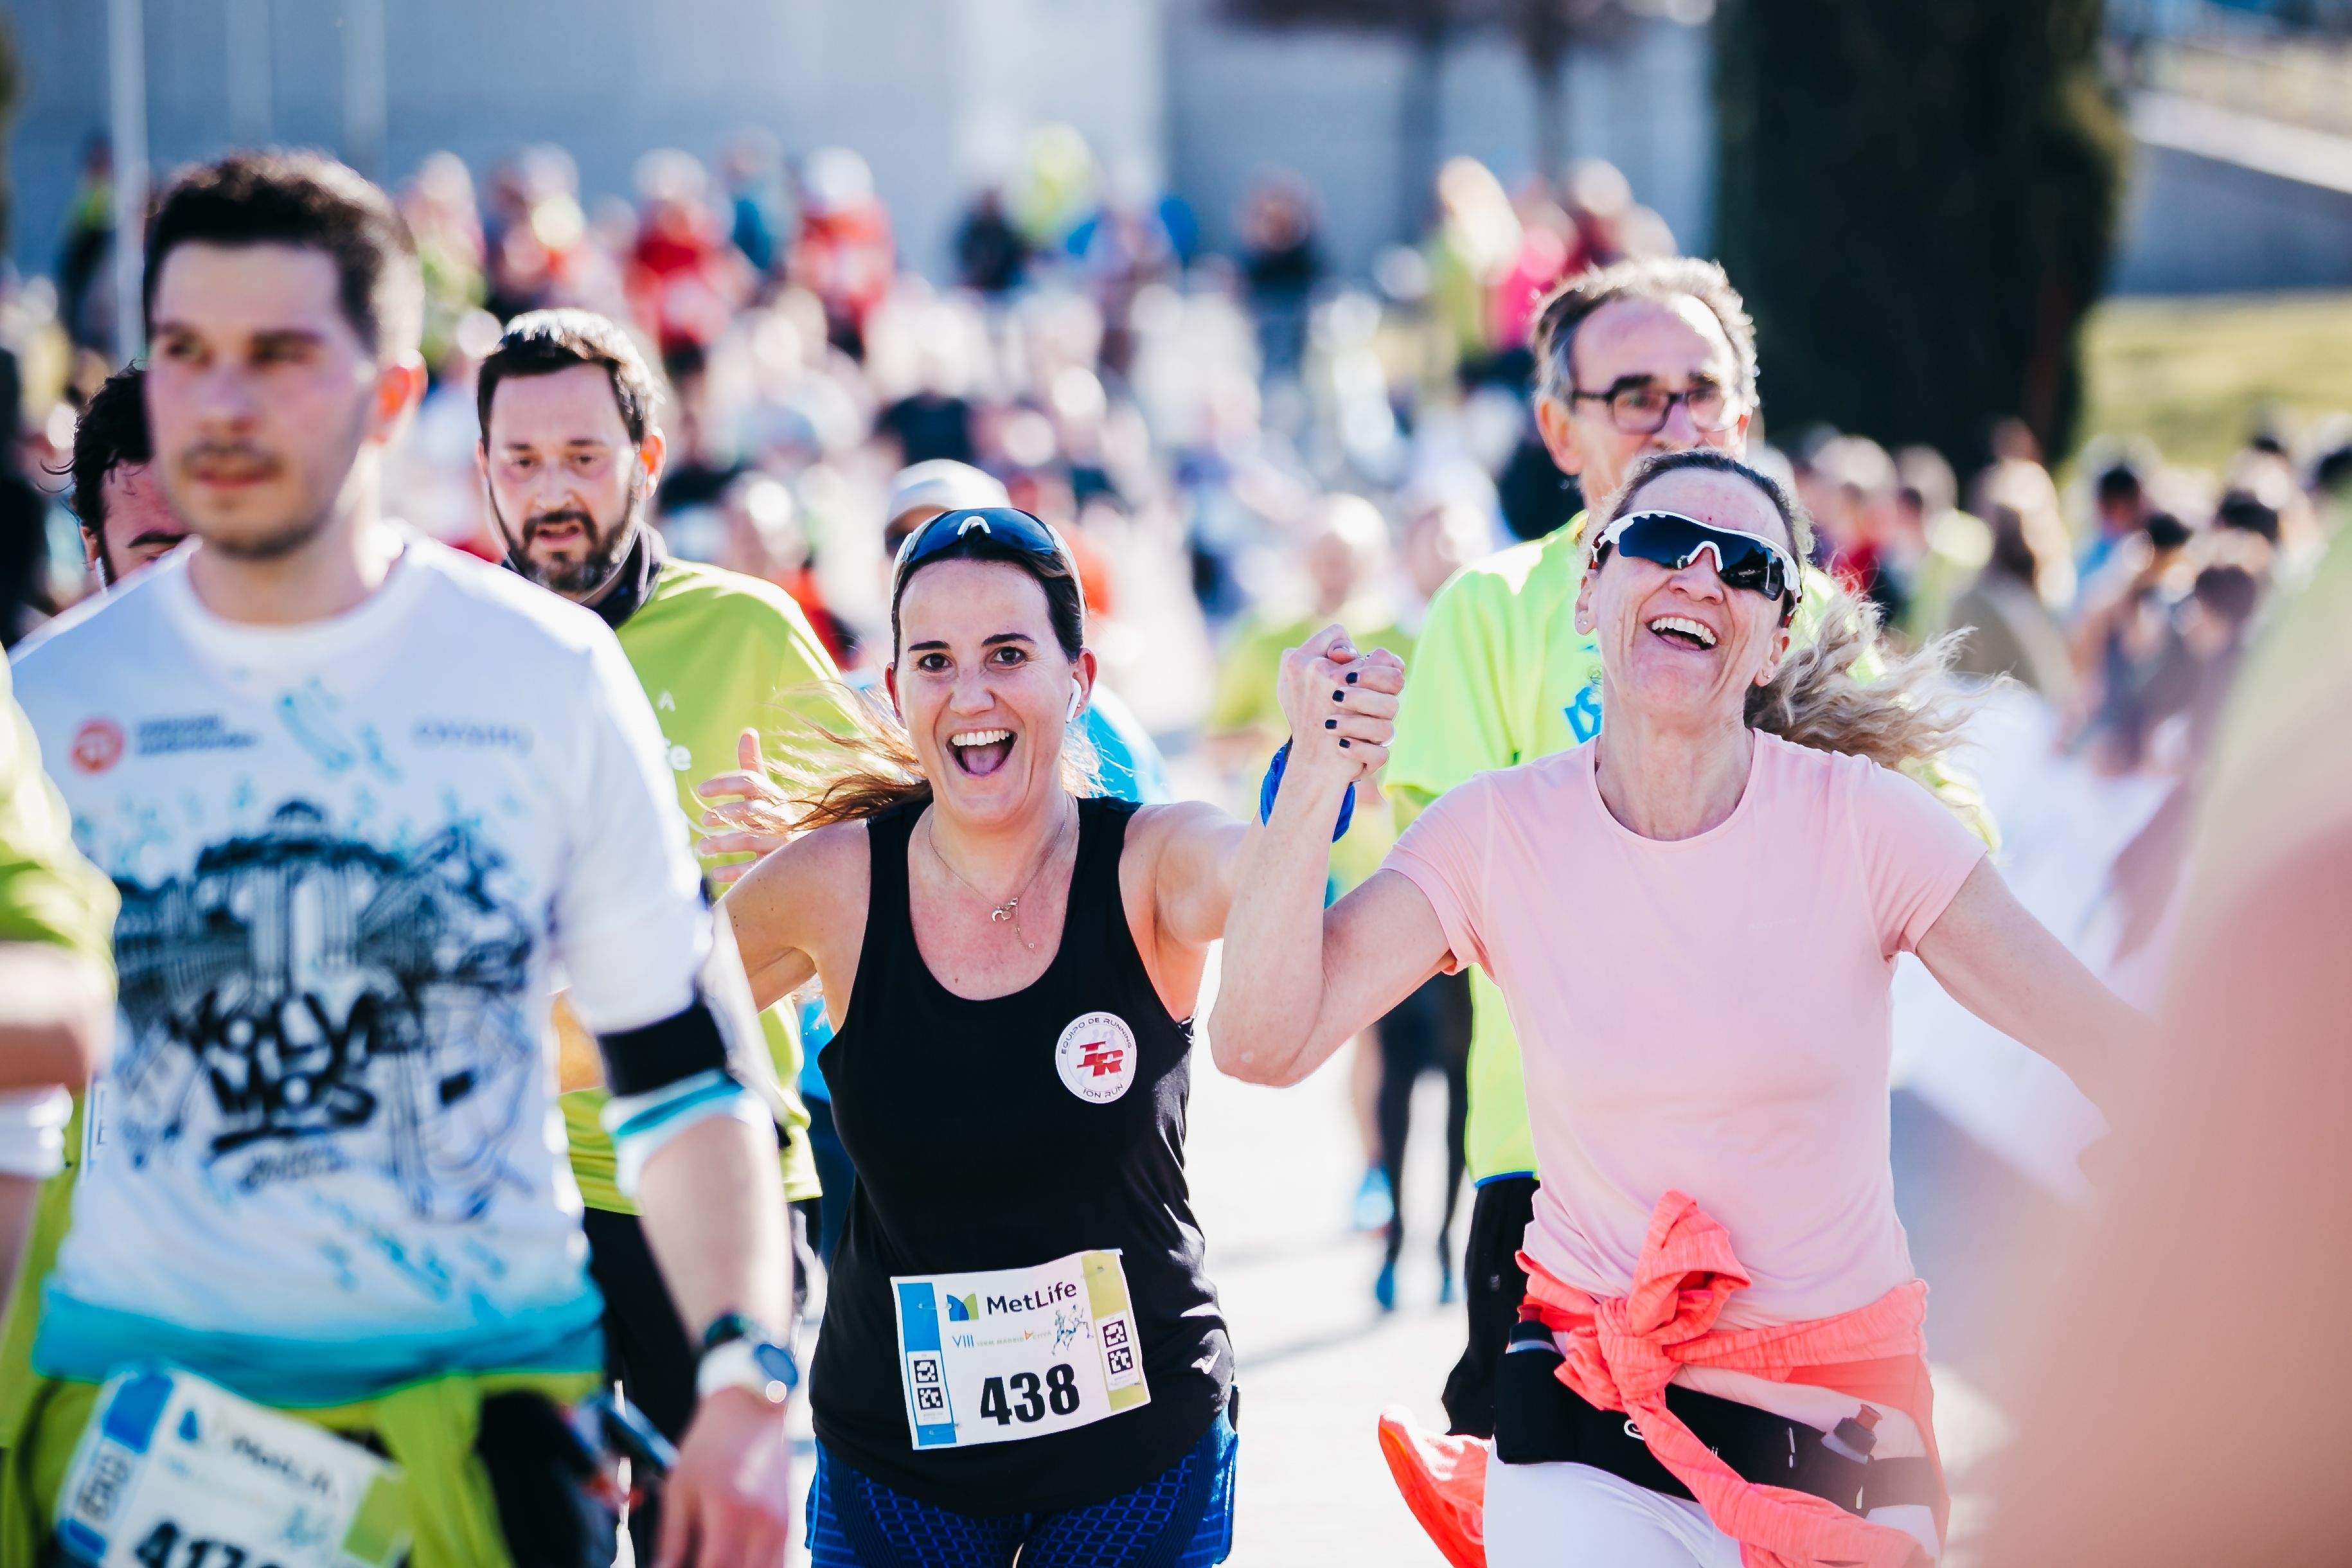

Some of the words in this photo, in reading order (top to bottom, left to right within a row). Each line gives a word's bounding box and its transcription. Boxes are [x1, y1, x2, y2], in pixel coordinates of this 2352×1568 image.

[1061, 1022, 1085, 1055] EQUIPO
[1088, 1017, 1100, 1027] DE
[1103, 1018, 1132, 1049] RUNNING
[1082, 1088, 1101, 1098] ION
[1105, 1083, 1123, 1098] RUN
[986, 1280, 1077, 1315] MetLife
[952, 1333, 975, 1349] VIII
[980, 1363, 1080, 1427] 438
